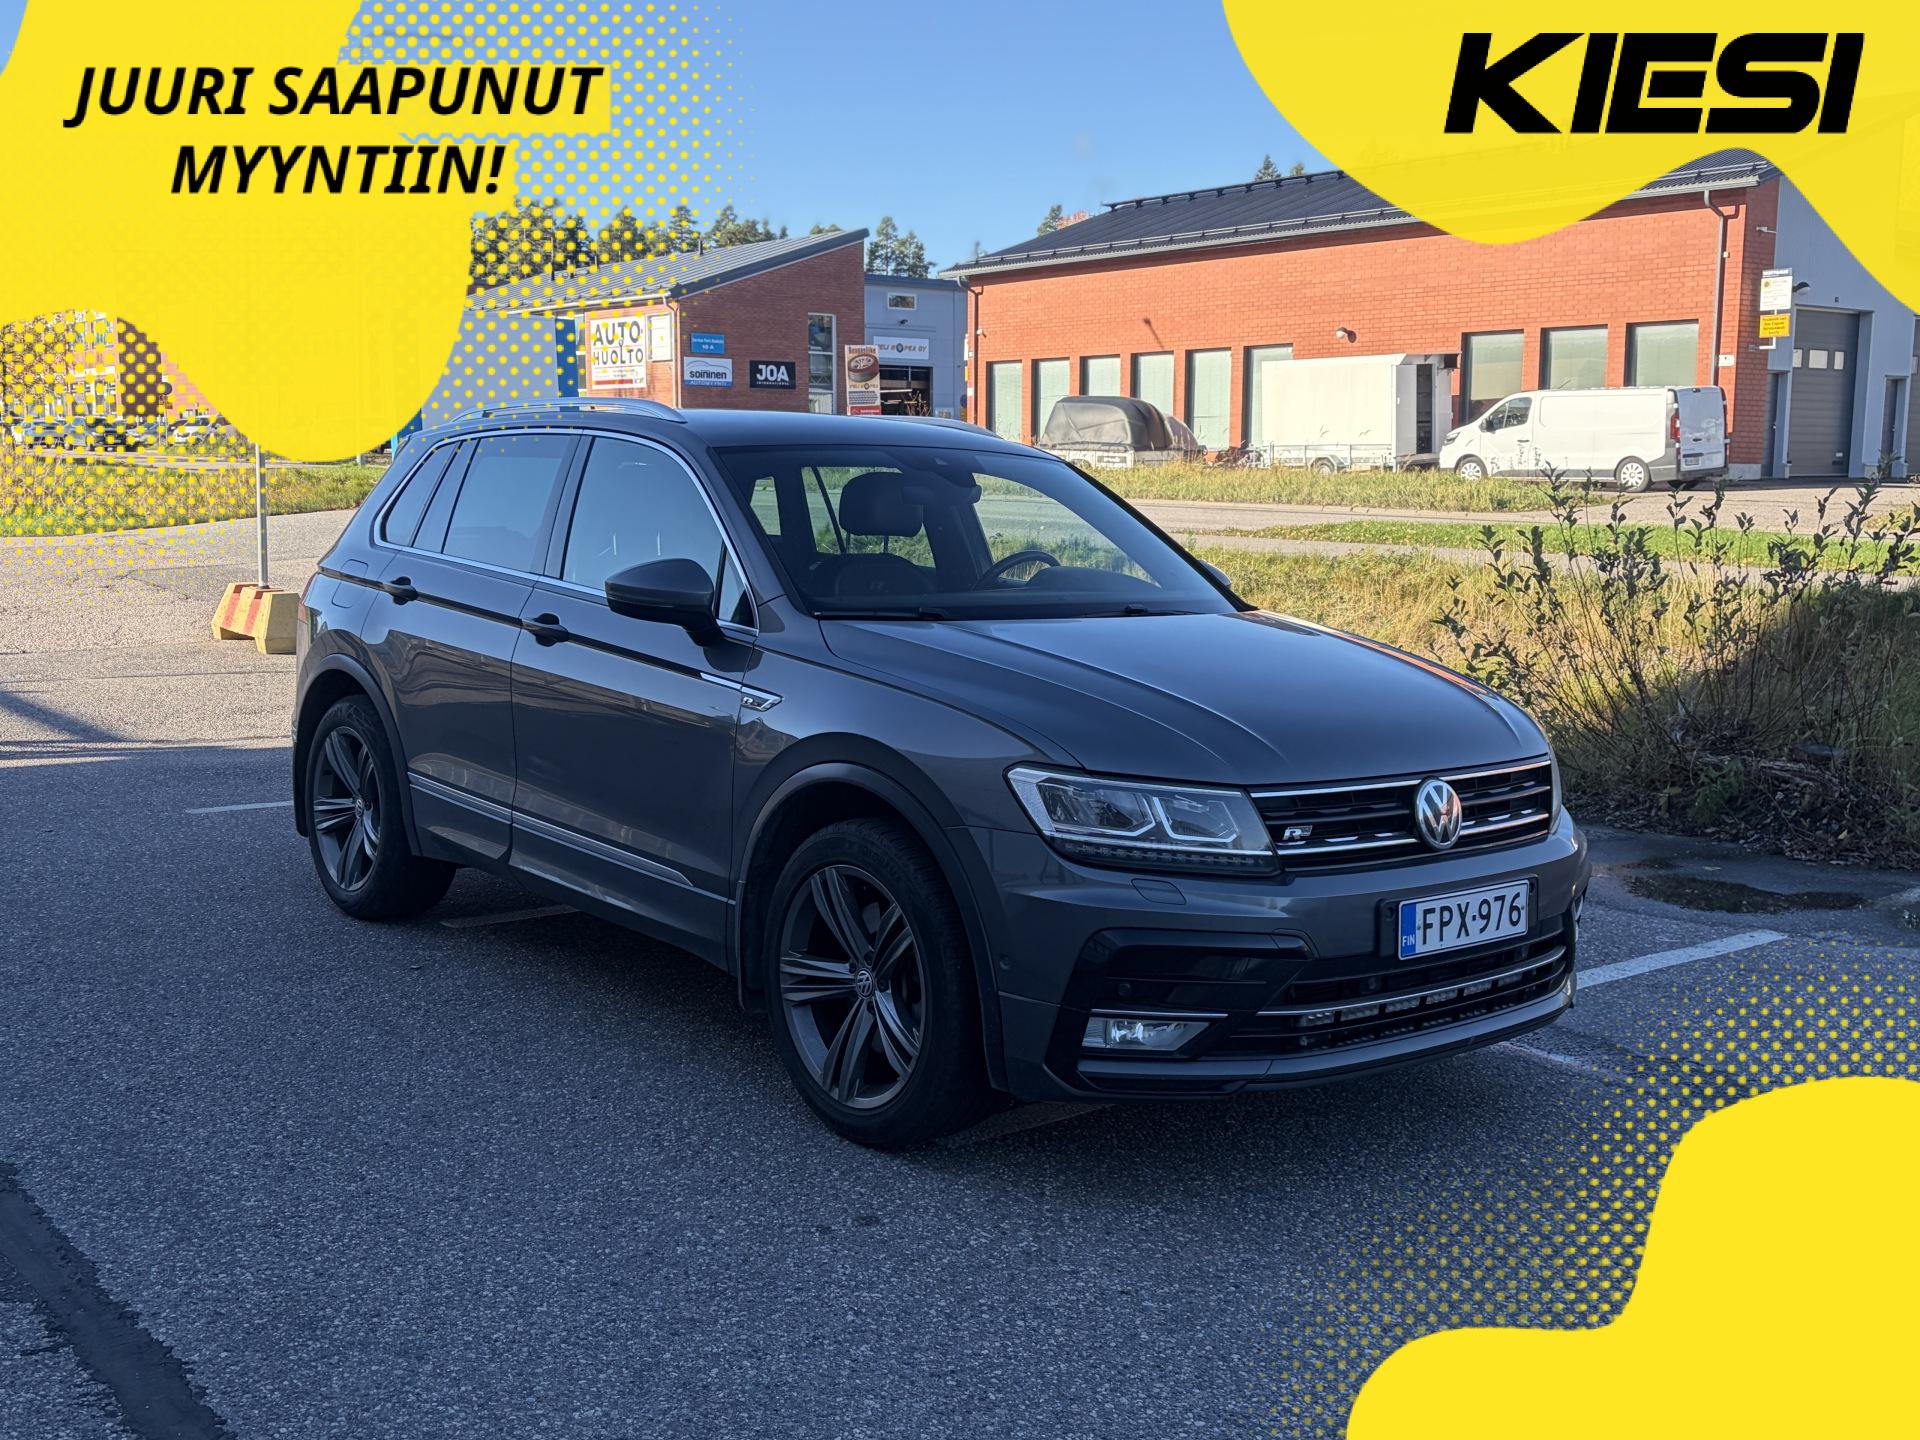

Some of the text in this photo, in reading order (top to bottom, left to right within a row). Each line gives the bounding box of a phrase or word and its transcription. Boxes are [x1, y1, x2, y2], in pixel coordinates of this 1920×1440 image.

[593, 348, 644, 366] HUOLTO
[689, 370, 727, 380] soininen
[756, 364, 790, 381] JOA
[1422, 892, 1522, 945] FPX-976
[1402, 934, 1416, 947] FIN
